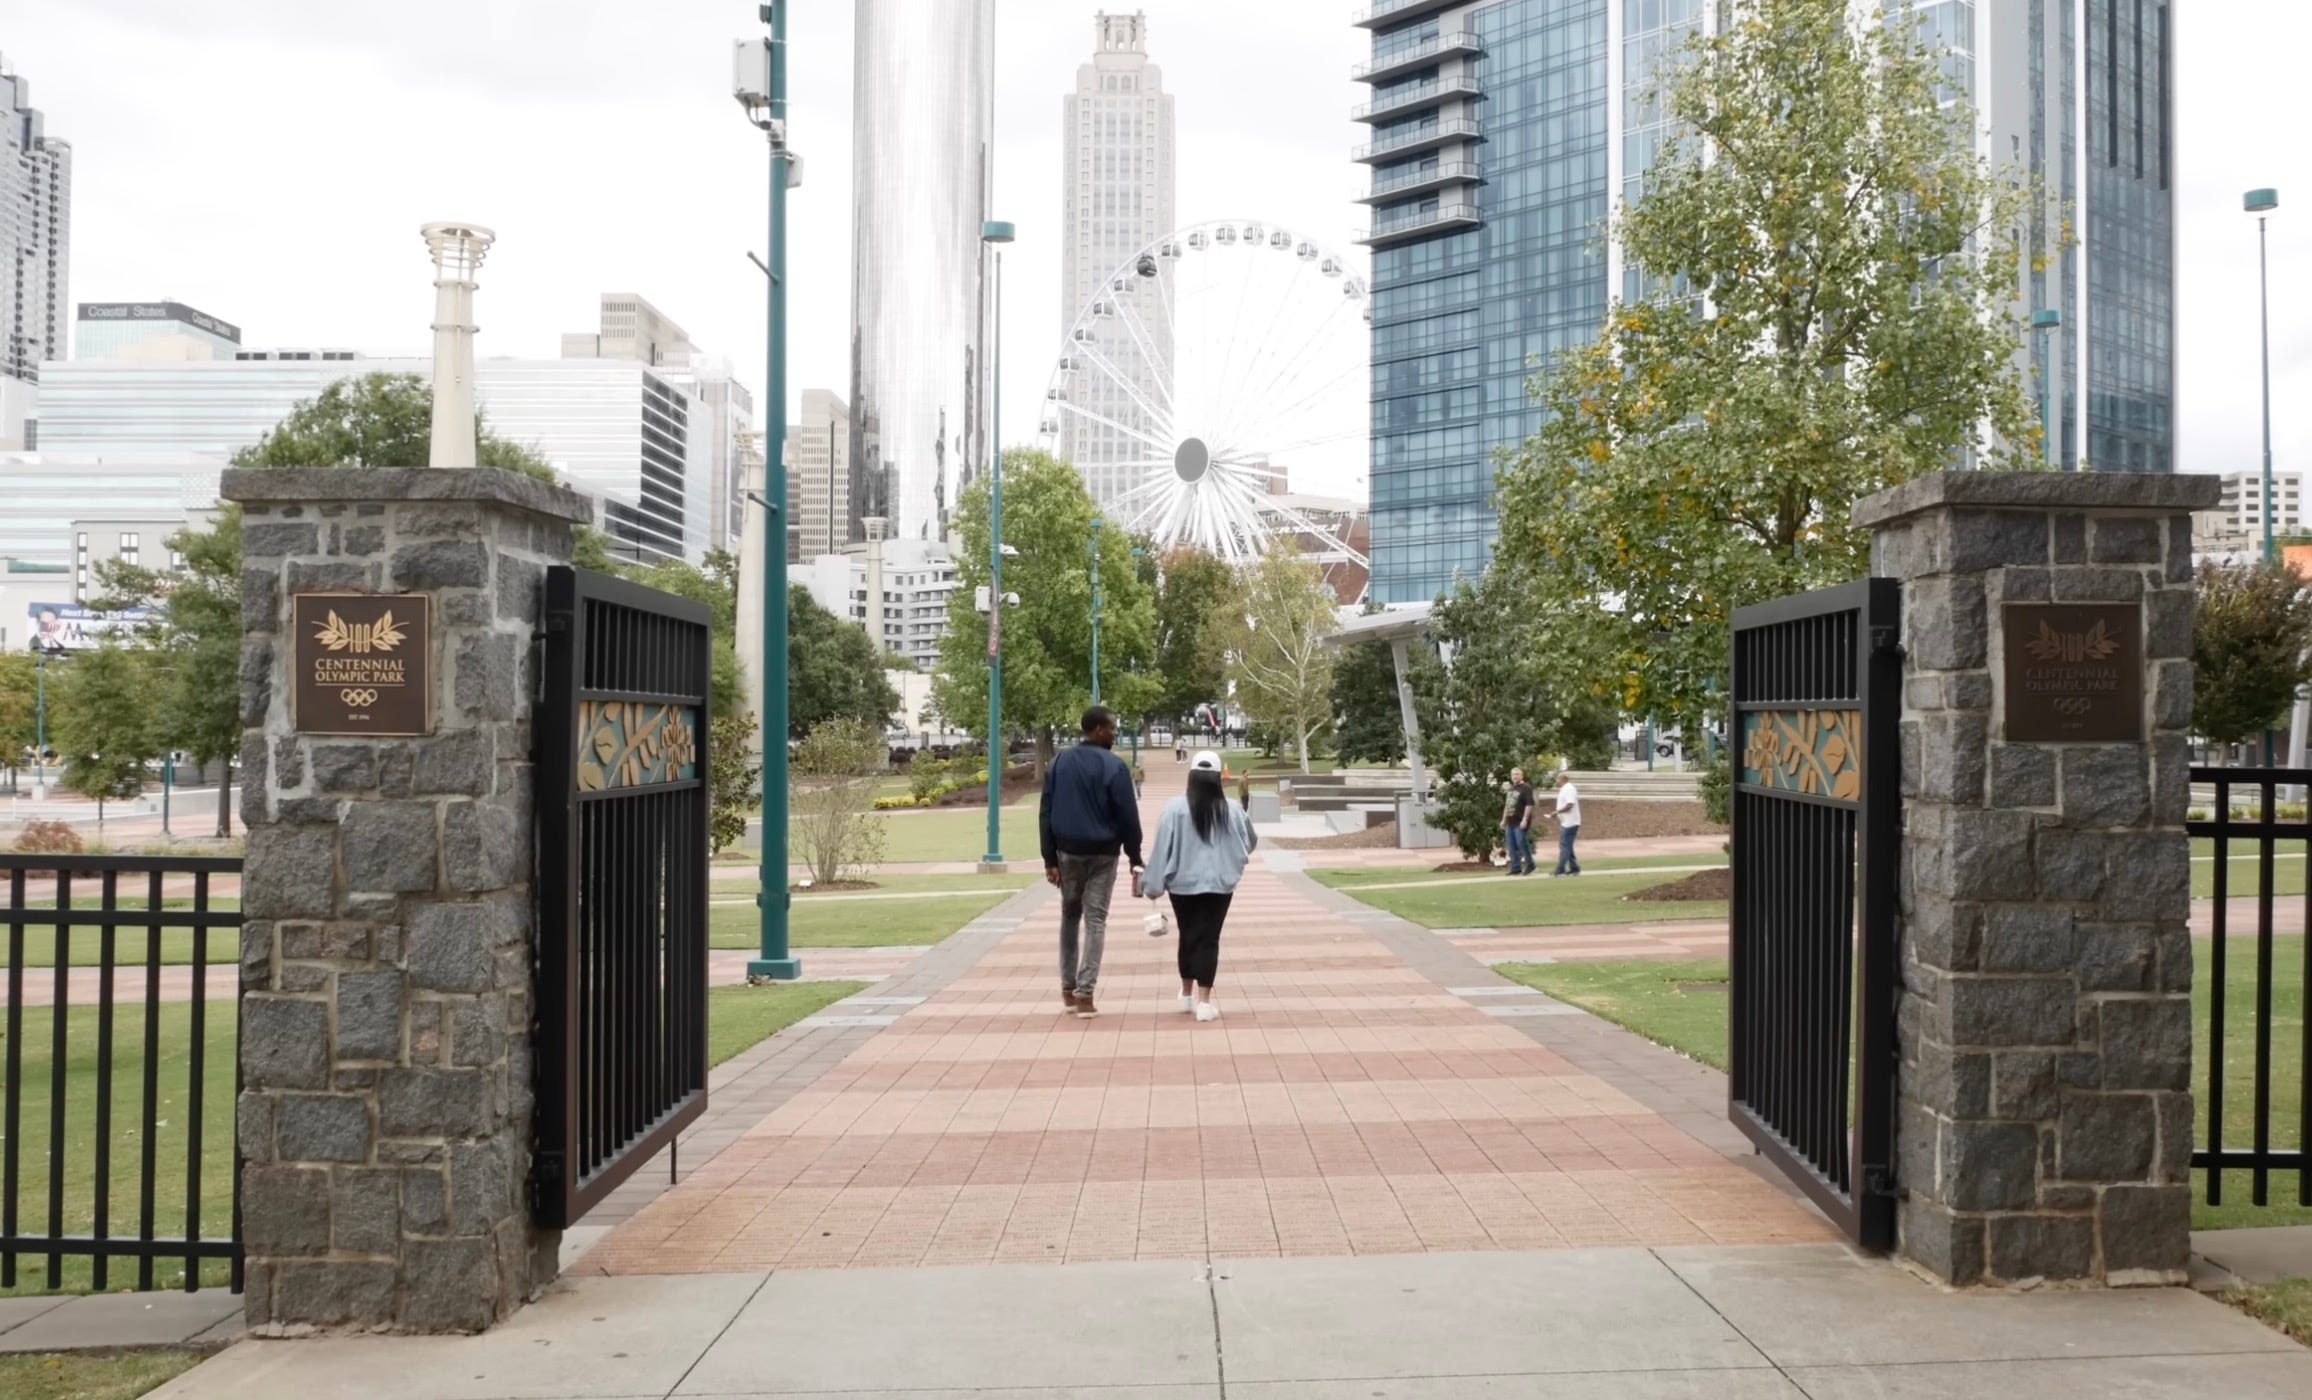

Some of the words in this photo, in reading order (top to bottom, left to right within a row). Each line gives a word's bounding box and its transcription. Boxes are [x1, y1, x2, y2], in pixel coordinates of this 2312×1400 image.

[88, 306, 128, 318] Coastal
[133, 305, 167, 317] States
[315, 658, 405, 671] CENTENNIAL
[315, 671, 371, 682] OLYMPIC
[373, 671, 405, 682] PARK
[2025, 667, 2118, 680] CENTENNIAL
[2025, 679, 2084, 691] OLYMPIC
[2087, 679, 2118, 690] PARK
